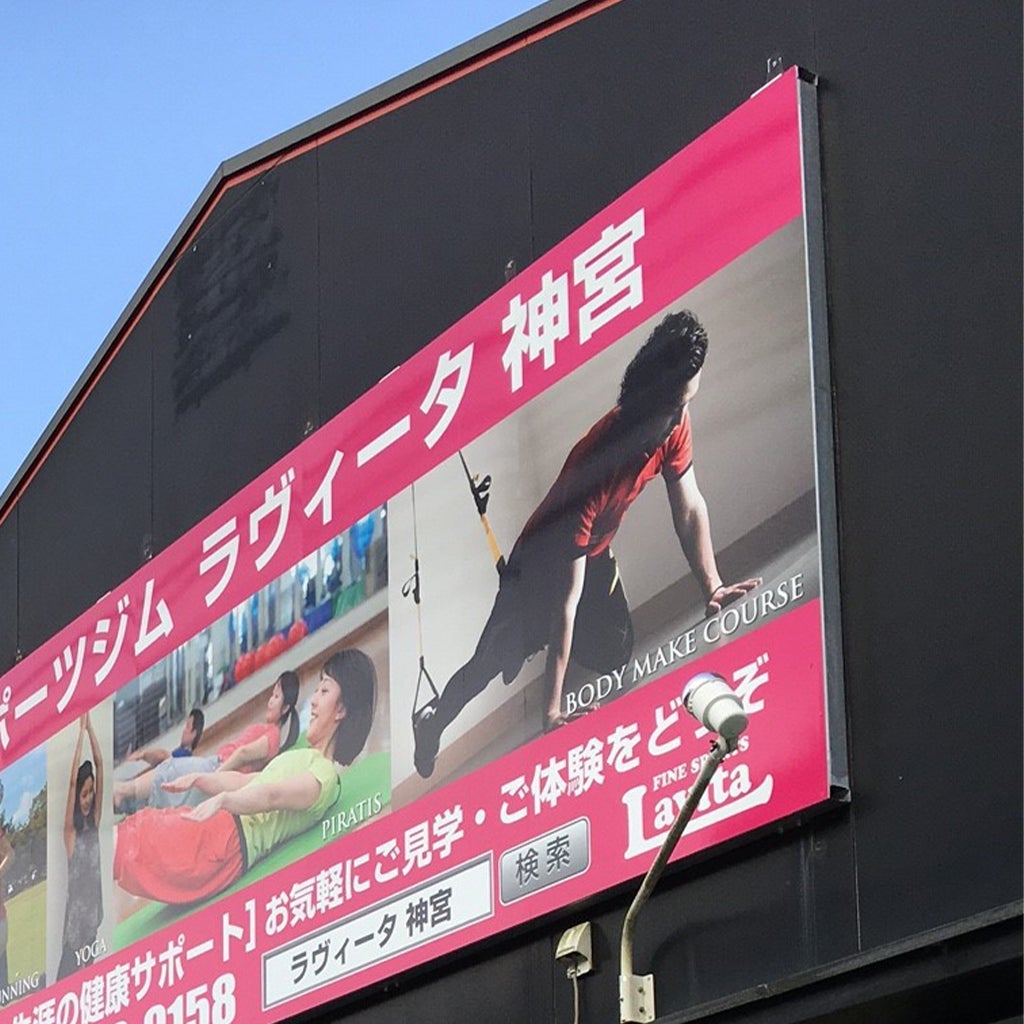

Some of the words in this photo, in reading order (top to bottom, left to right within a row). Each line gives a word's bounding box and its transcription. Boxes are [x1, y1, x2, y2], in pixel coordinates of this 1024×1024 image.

[198, 343, 475, 607] ラヴィータ
[501, 207, 646, 393] 神宮
[565, 664, 627, 716] BODY
[631, 628, 697, 683] MAKE
[703, 574, 805, 643] COURSE
[265, 652, 770, 934] お気軽にご見学・ご体験をどぞ
[652, 763, 688, 791] FINE
[321, 793, 383, 839] PIRATIS
[515, 836, 571, 885] 検索
[74, 939, 108, 967] YOGA
[290, 915, 397, 985] ラヴィータ
[406, 887, 453, 938] 神宮
